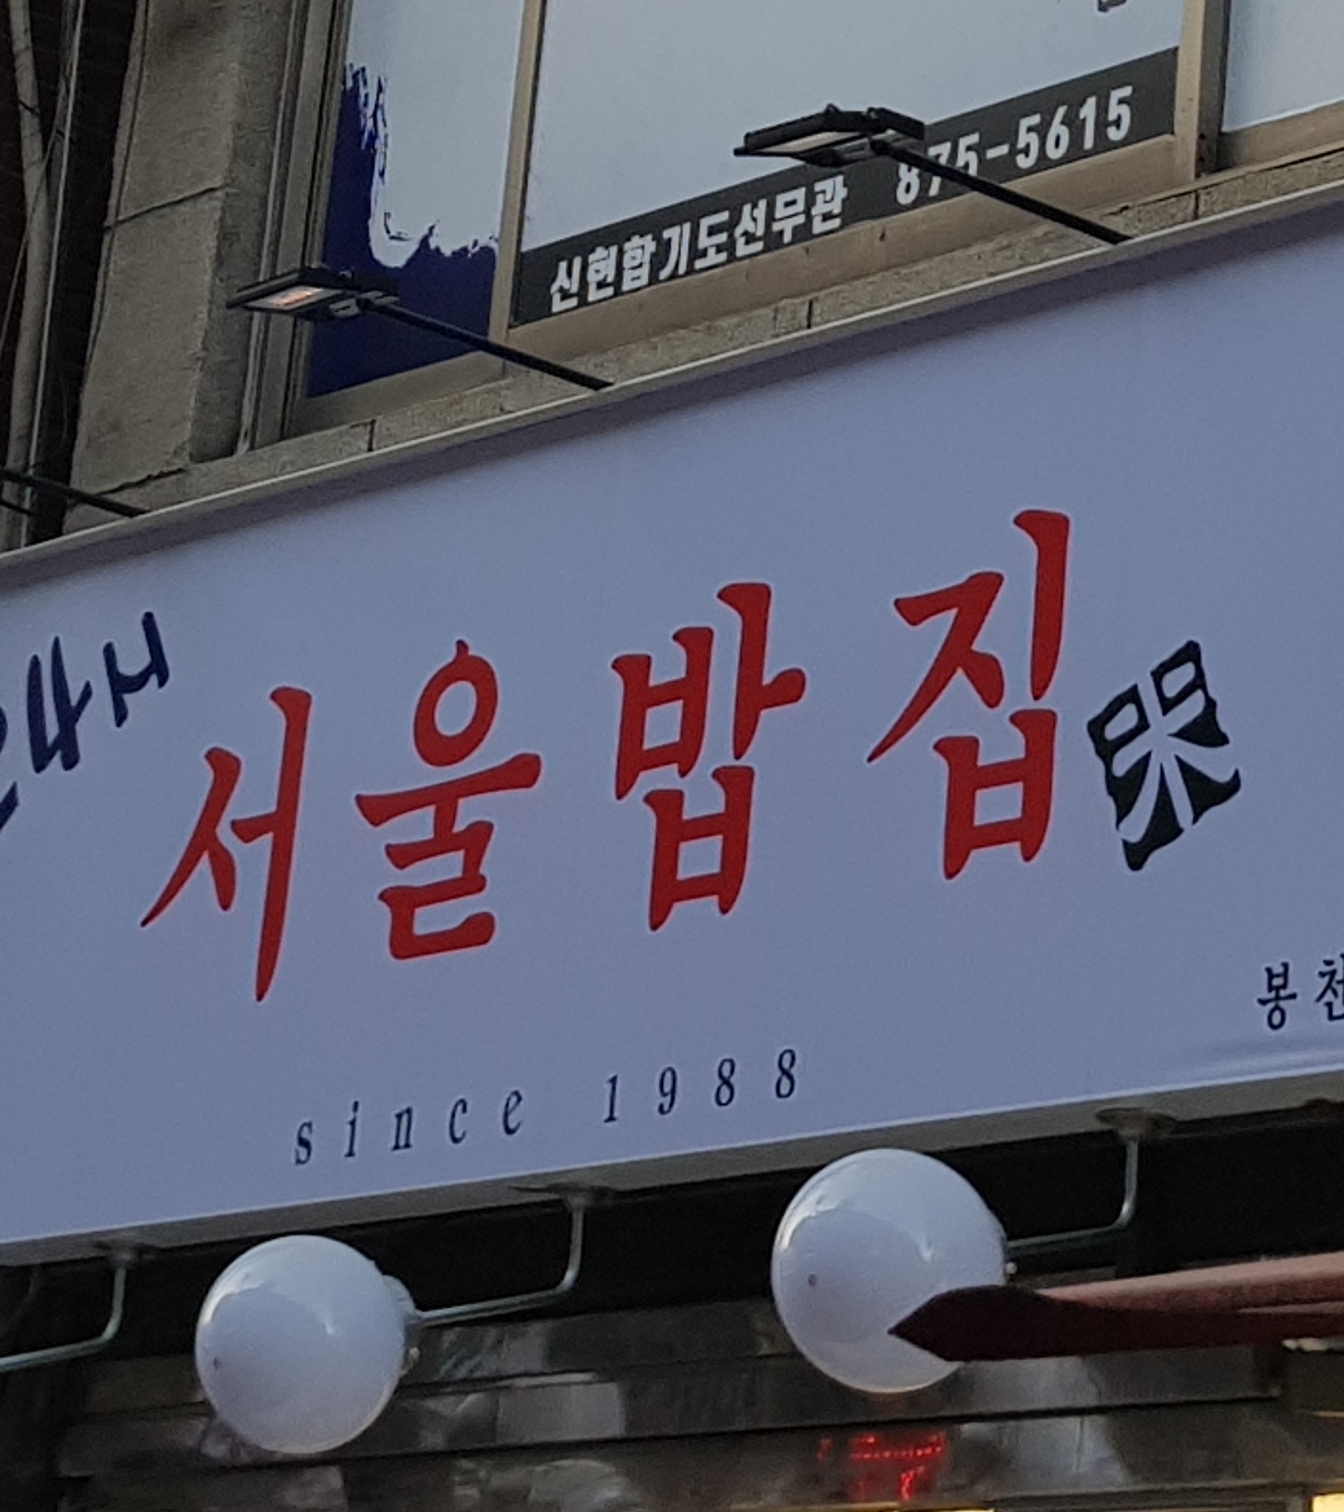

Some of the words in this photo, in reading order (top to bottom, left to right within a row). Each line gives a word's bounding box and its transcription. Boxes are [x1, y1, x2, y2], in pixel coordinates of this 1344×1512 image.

[896, 85, 1133, 205] 875-5615
[140, 509, 1070, 1003] 서울밥집
[293, 1087, 524, 1167] since
[602, 1048, 798, 1125] 1988
